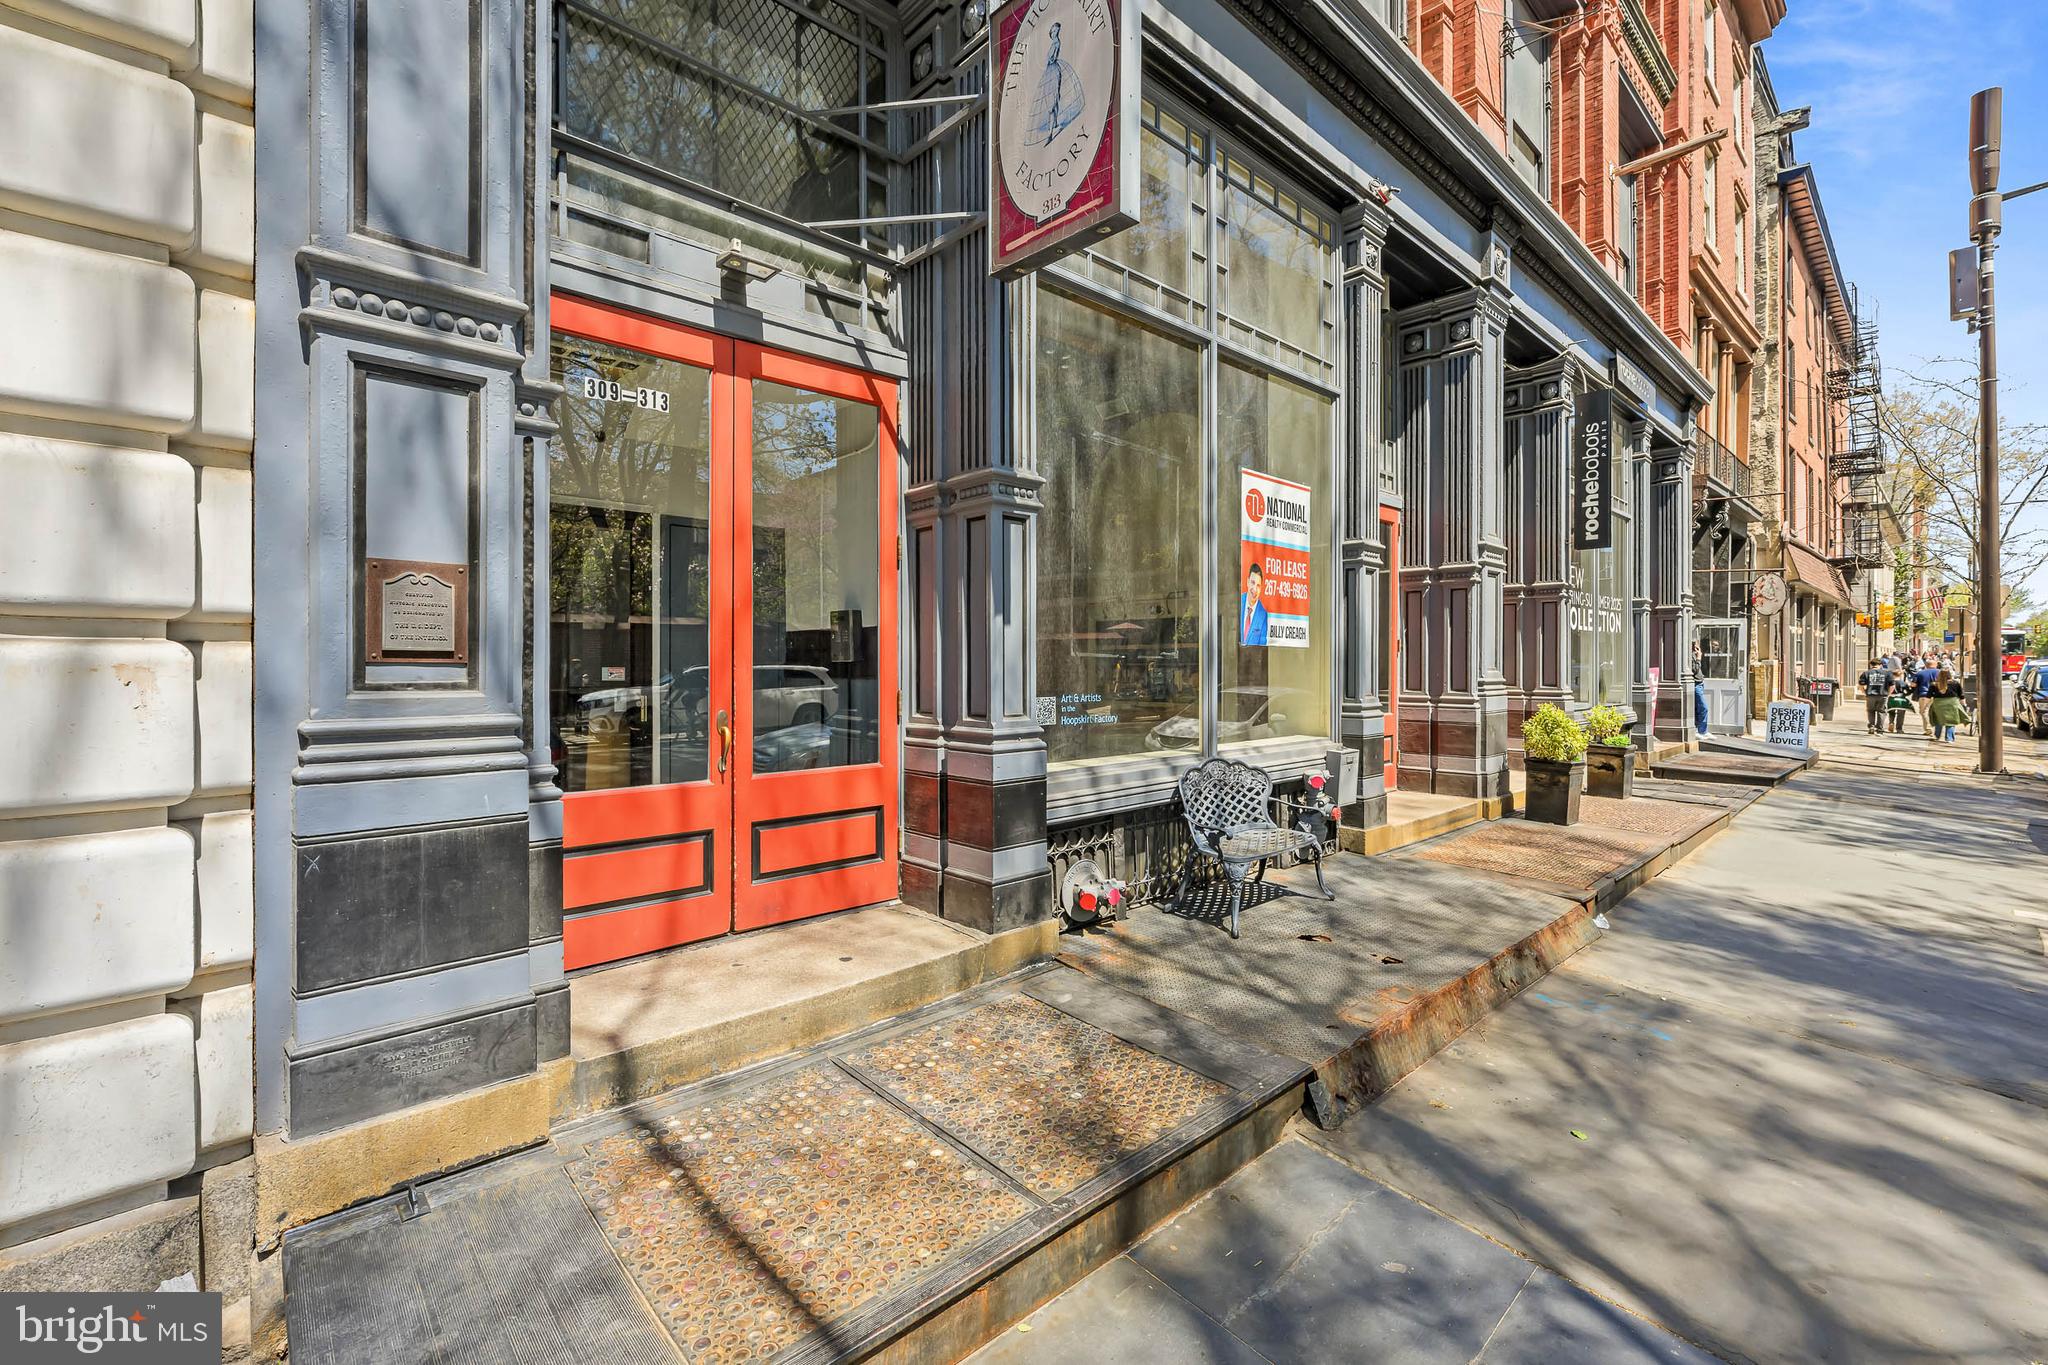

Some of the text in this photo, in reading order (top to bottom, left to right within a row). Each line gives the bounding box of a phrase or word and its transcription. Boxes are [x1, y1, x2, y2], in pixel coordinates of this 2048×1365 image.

[1005, 42, 1028, 97] THE
[1015, 125, 1090, 192] FACTORY
[1042, 193, 1062, 215] 313
[1581, 422, 1600, 541] rochebobois
[1266, 496, 1307, 523] NATIONAL
[1266, 517, 1308, 535] REALTY COMMERCIAL
[1265, 557, 1307, 579] FOR LEASE
[1569, 565, 1584, 589] EW
[1570, 606, 1622, 633] OLLETION
[1270, 625, 1285, 639] BILLY
[1060, 693, 1102, 703] Art & Artists
[1060, 714, 1119, 727] Hoopskirt Factory
[1771, 707, 1806, 716] DESIGN
[1769, 737, 1803, 746] ADVICE
